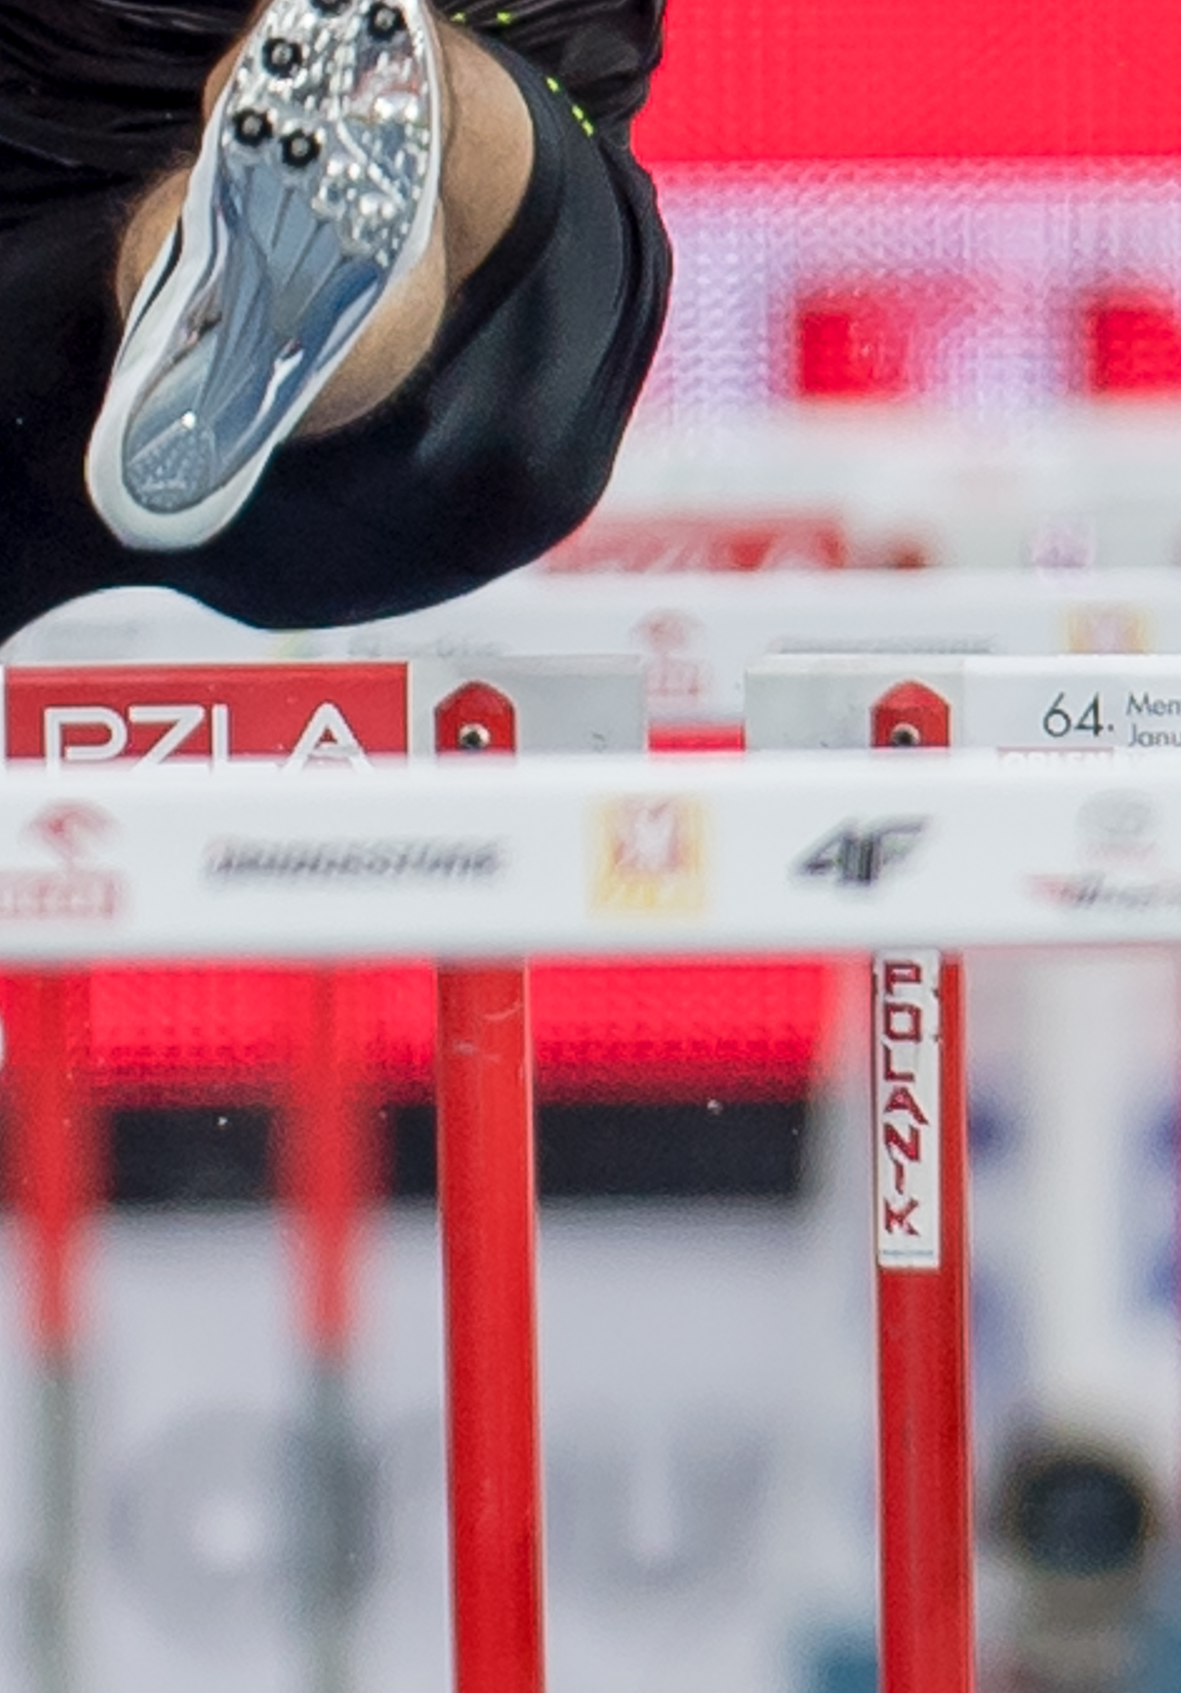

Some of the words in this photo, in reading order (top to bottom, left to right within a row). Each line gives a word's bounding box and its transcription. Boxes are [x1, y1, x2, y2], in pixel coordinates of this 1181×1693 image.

[43, 703, 376, 777] PZLA
[1042, 691, 1114, 738] 64.
[882, 961, 929, 1237] POLANIK
